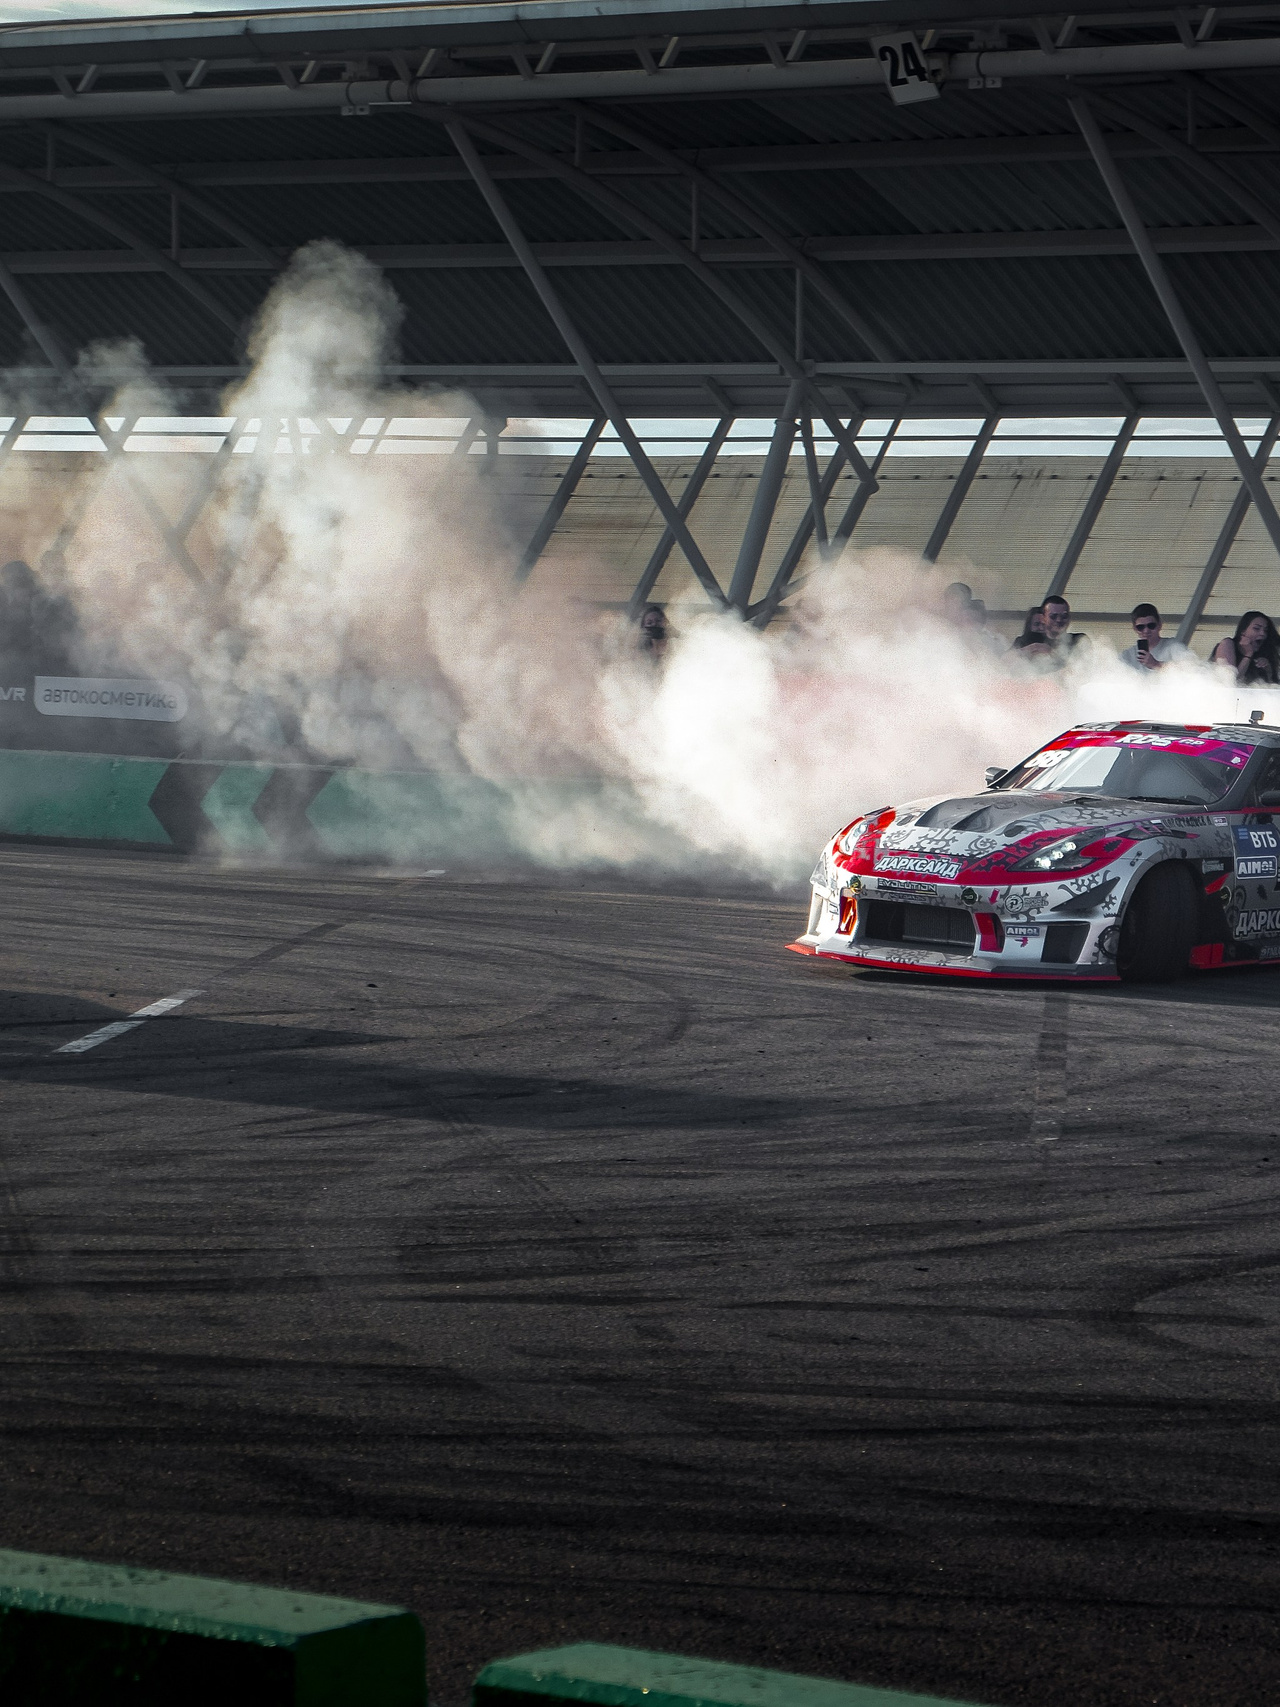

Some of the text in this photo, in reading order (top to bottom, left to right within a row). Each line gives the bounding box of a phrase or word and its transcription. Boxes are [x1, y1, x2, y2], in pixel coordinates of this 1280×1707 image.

[878, 42, 928, 87] 24
[43, 688, 178, 709] автокосметика
[1114, 733, 1181, 747] RDS
[1249, 830, 1277, 849] ВТБ
[874, 857, 959, 878] ДАРКСАЙД
[1238, 859, 1275, 874] AIMOL
[878, 879, 936, 892] EVOLUTION
[1006, 927, 1039, 935] AIMOL
